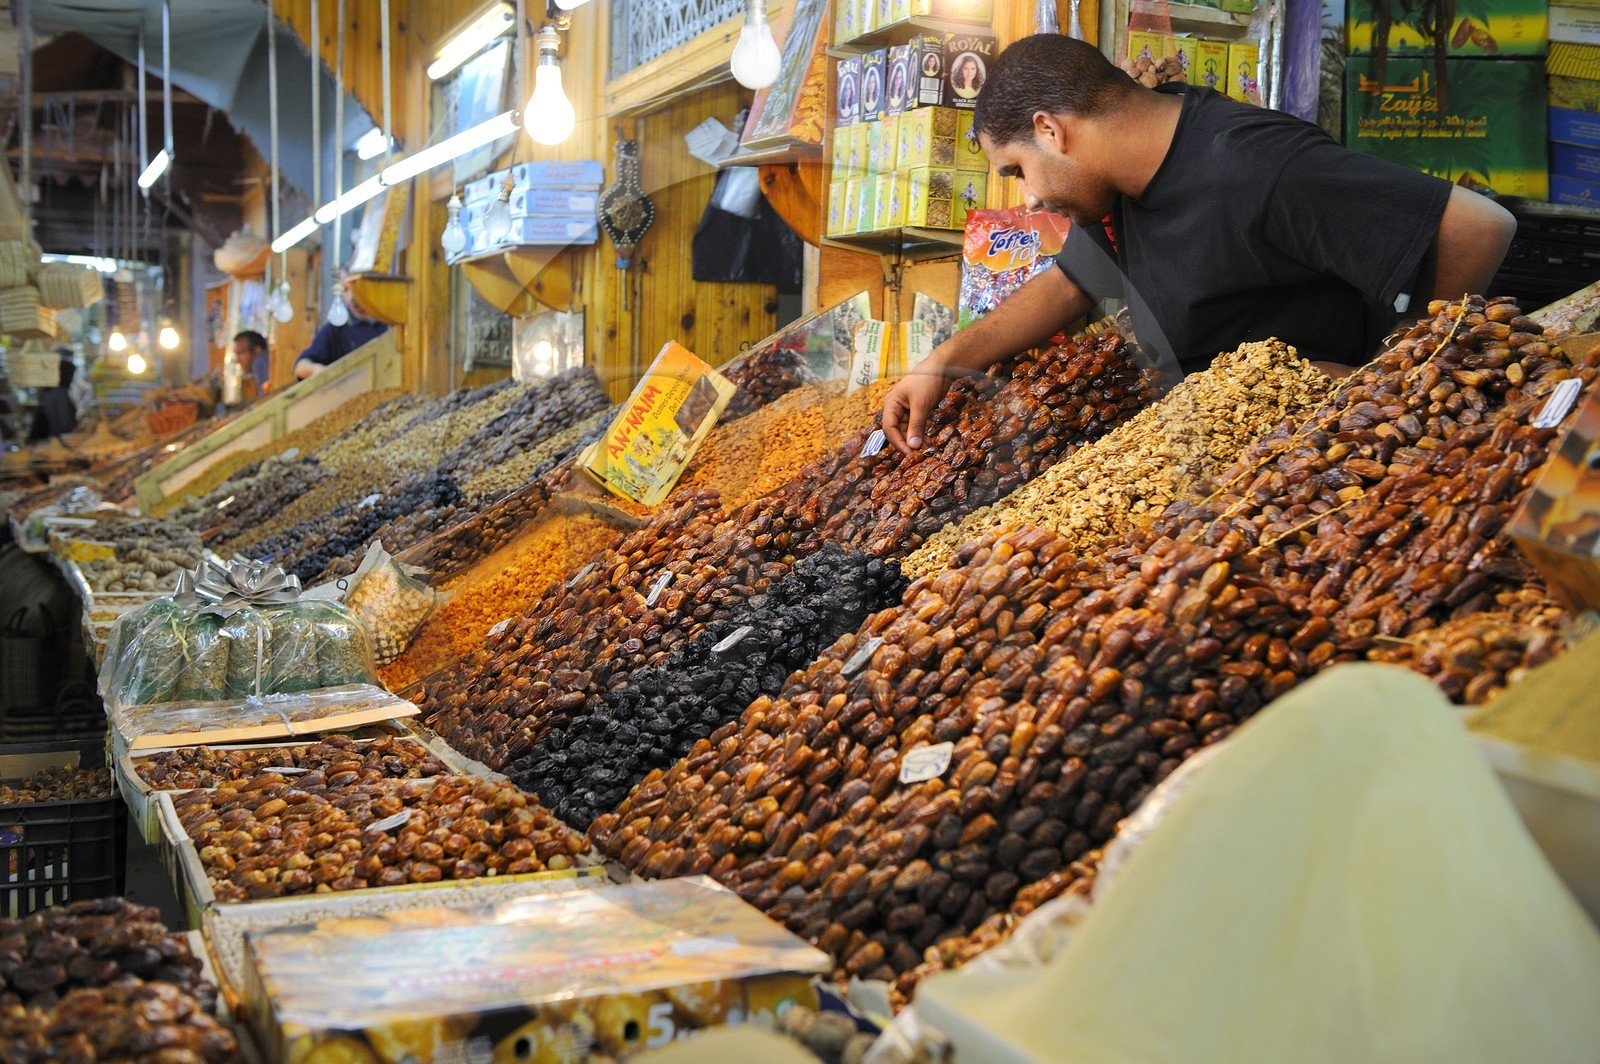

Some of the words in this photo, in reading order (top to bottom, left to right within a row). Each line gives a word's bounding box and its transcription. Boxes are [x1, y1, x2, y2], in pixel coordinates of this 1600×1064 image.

[948, 37, 991, 55] ROYAL
[988, 226, 1038, 256] Toffee
[652, 400, 669, 420] Dattes
[665, 377, 682, 400] Deglet
[669, 402, 678, 413] De
[674, 380, 693, 403] Tunisie
[607, 384, 662, 460] AN-NAIM
[646, 1001, 675, 1050] 5
